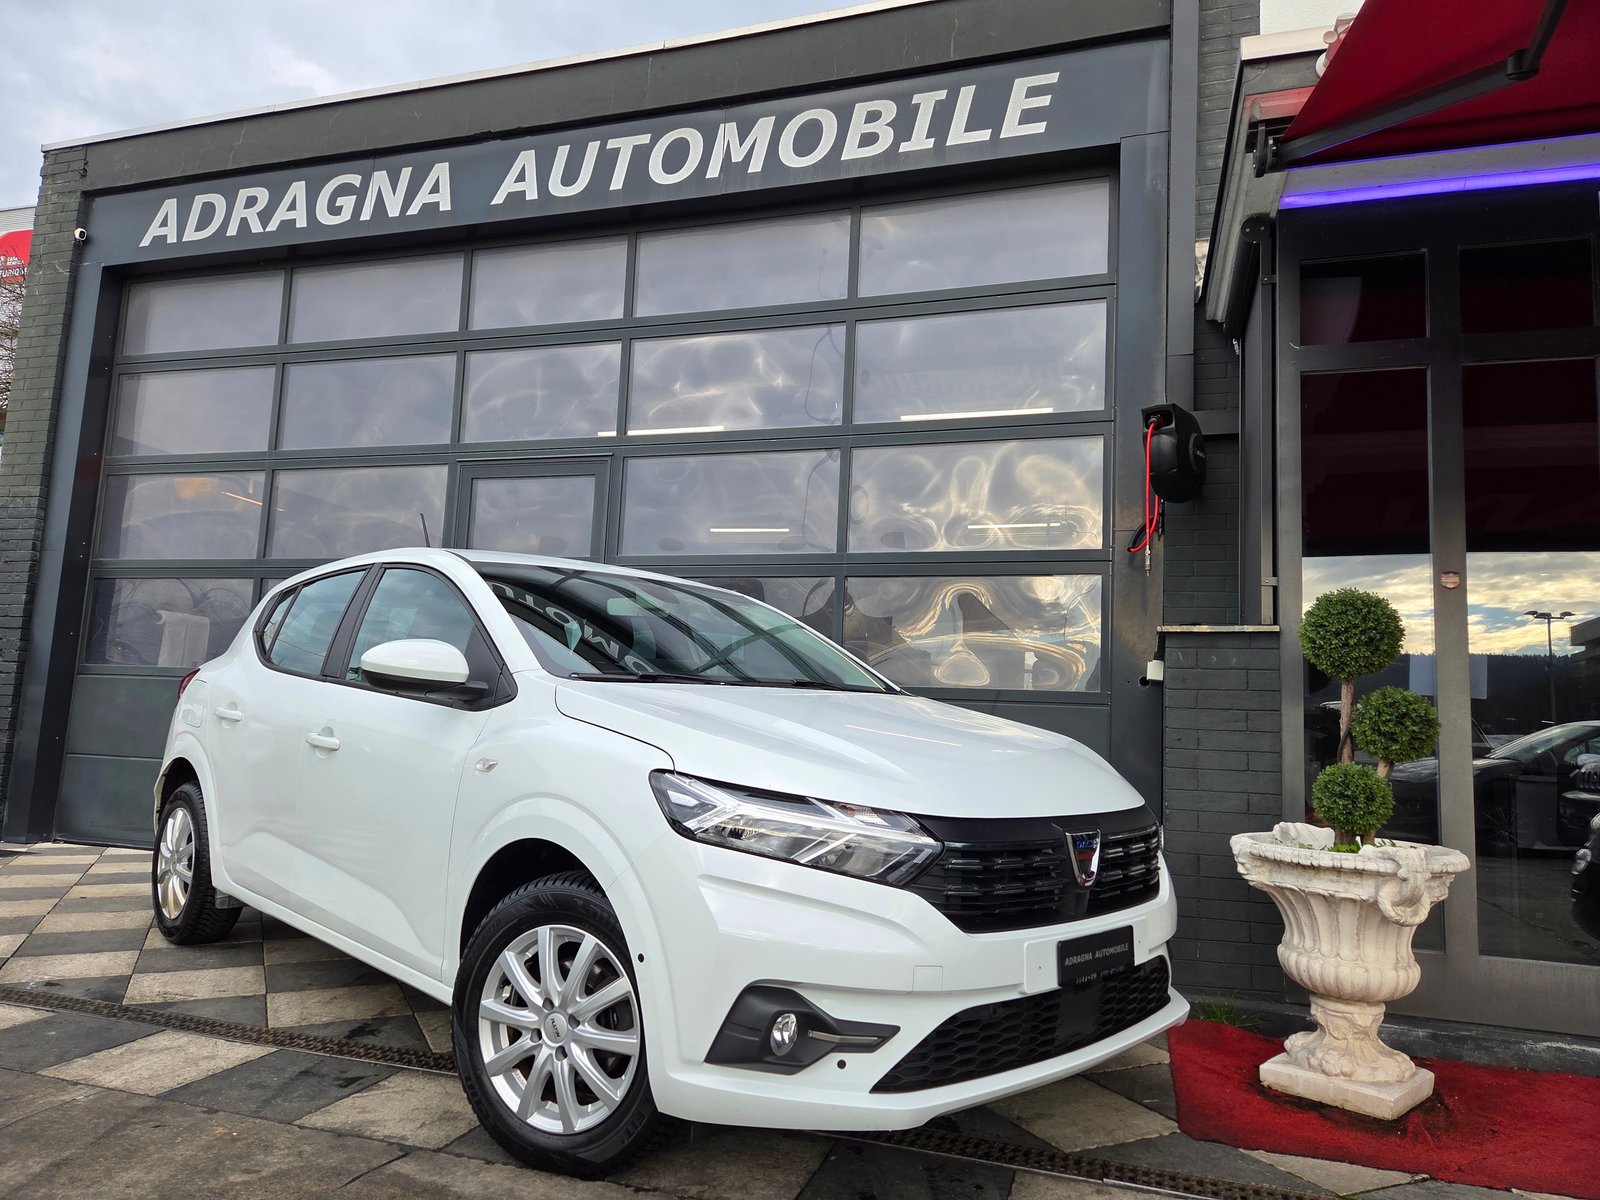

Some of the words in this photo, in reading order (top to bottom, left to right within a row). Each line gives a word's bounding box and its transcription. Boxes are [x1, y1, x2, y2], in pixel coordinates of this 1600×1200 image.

[139, 161, 452, 248] ADRAGNA
[490, 71, 1061, 206] AUTOMOBILE
[1064, 951, 1093, 967] ADRAGNA
[1095, 942, 1129, 958] AUTOMOBILE
